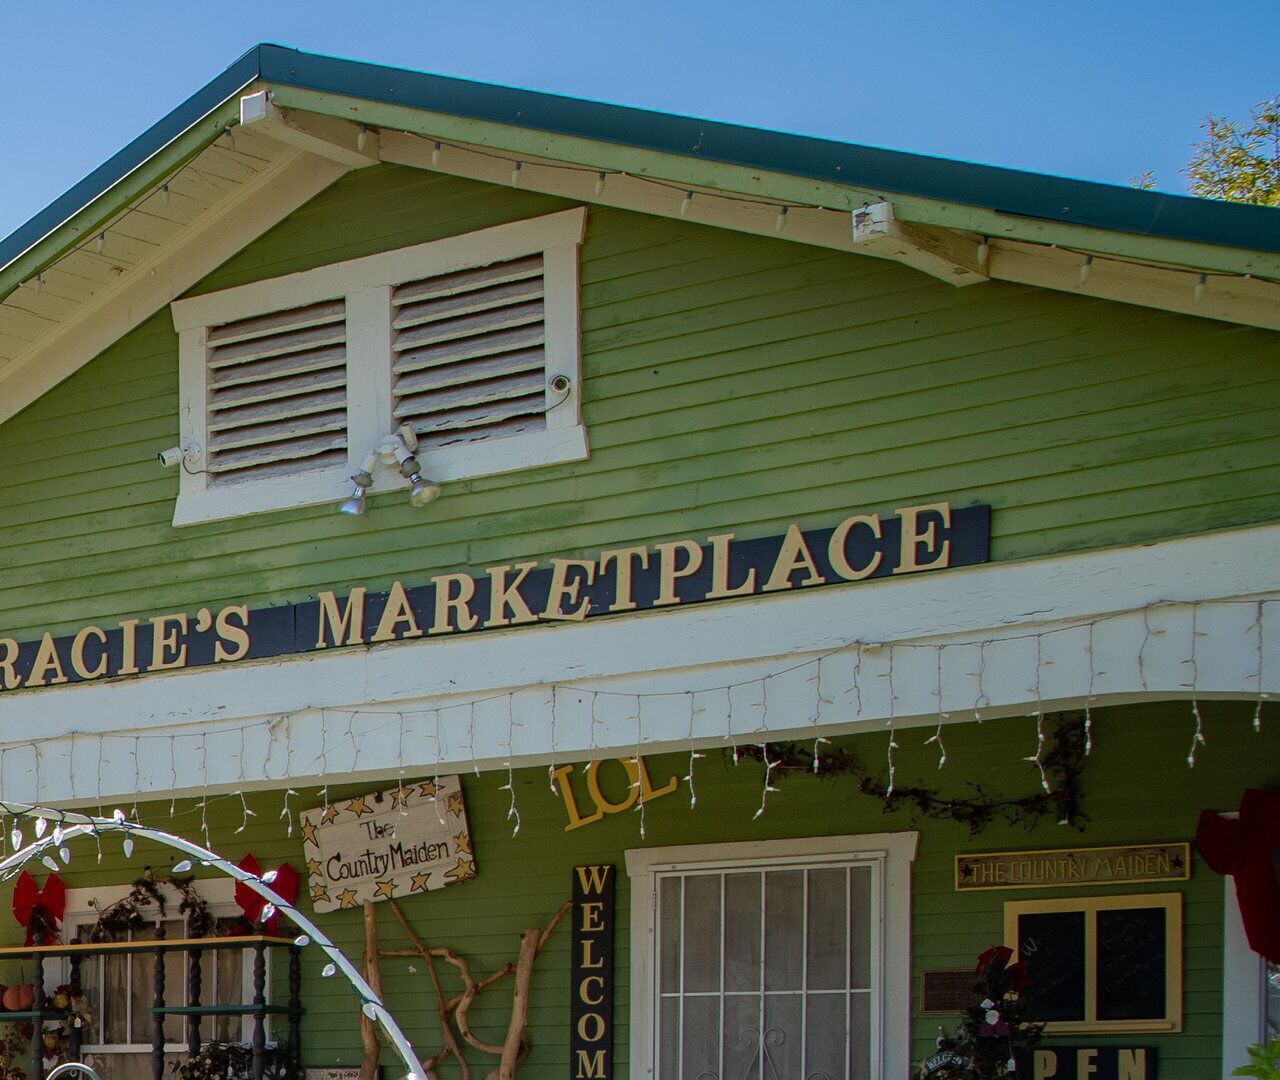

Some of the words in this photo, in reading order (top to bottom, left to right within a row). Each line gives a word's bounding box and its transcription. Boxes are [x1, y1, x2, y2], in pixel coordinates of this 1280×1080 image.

[315, 501, 954, 650] MARKETPLACE
[359, 820, 394, 840] The
[326, 848, 389, 881] Country
[389, 841, 450, 870] Maiden
[971, 862, 1005, 883] THE
[1010, 858, 1086, 881] COUNTRY
[1093, 854, 1171, 877] MAIDEN
